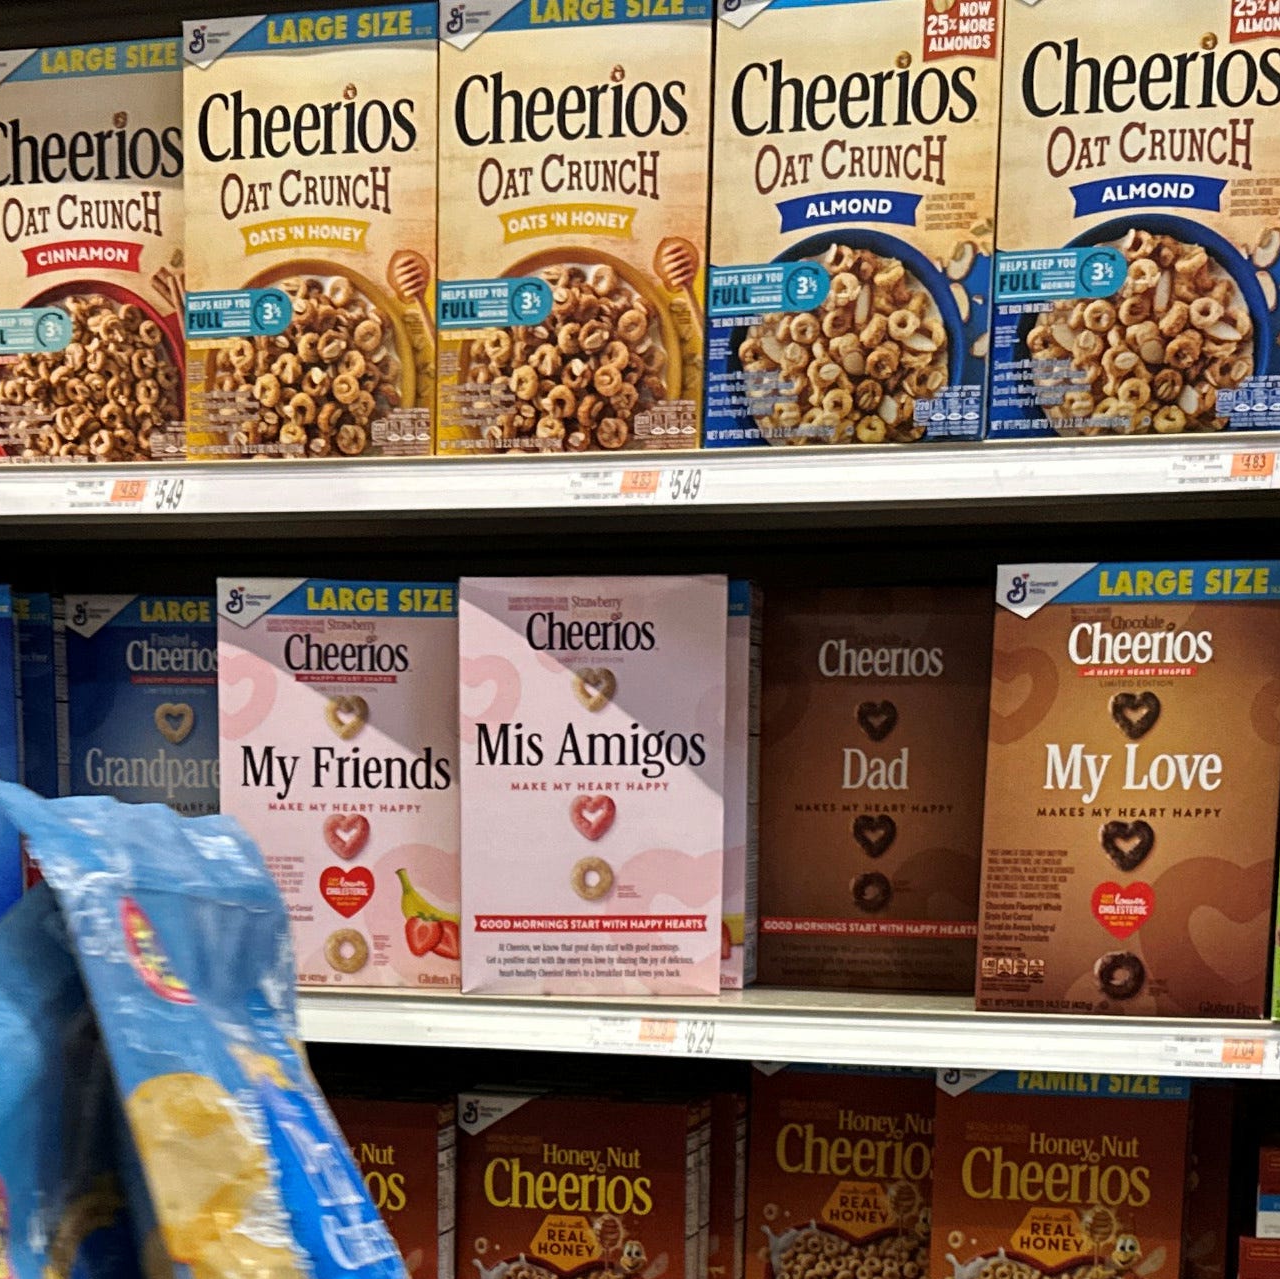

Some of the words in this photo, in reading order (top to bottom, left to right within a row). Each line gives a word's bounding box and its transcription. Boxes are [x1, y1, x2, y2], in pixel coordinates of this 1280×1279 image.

[960, 2, 993, 17] NOW
[266, 21, 348, 45] LARGE
[357, 15, 413, 38] SIZE
[959, 16, 996, 35] MORE
[198, 83, 417, 162] Cheerios
[1101, 181, 1195, 203] ALMOND
[806, 196, 892, 218] ALMOND
[36, 245, 129, 267] CINNAMON
[441, 302, 476, 320] FULL
[1098, 569, 1194, 597] LARGE
[1206, 568, 1270, 595] SIZE
[306, 587, 388, 612] LARGE
[399, 588, 453, 611] SIZE
[327, 619, 376, 634] Strawberry
[1068, 622, 1213, 665] Cheerios
[475, 723, 544, 768] Mis
[556, 722, 706, 778] Amigos
[240, 745, 300, 800] My
[312, 746, 452, 791] Friends
[841, 748, 909, 791] Dad
[510, 782, 547, 791] MAKE
[553, 782, 572, 791] MY
[577, 781, 621, 792] HEART
[626, 782, 669, 792] HAPPY
[480, 920, 511, 929] GOOD
[513, 920, 568, 929] MORNINGS
[571, 920, 600, 929] START
[603, 920, 627, 929] WITH
[630, 920, 663, 929] HAPPY
[665, 919, 703, 929] HEARTS
[542, 1144, 601, 1172] Honey
[606, 1147, 640, 1169] Nut
[1029, 1133, 1093, 1162] Honey
[1101, 1136, 1139, 1158] Nut
[484, 1158, 652, 1216] Cheerios
[1020, 1235, 1084, 1253] HONEY
